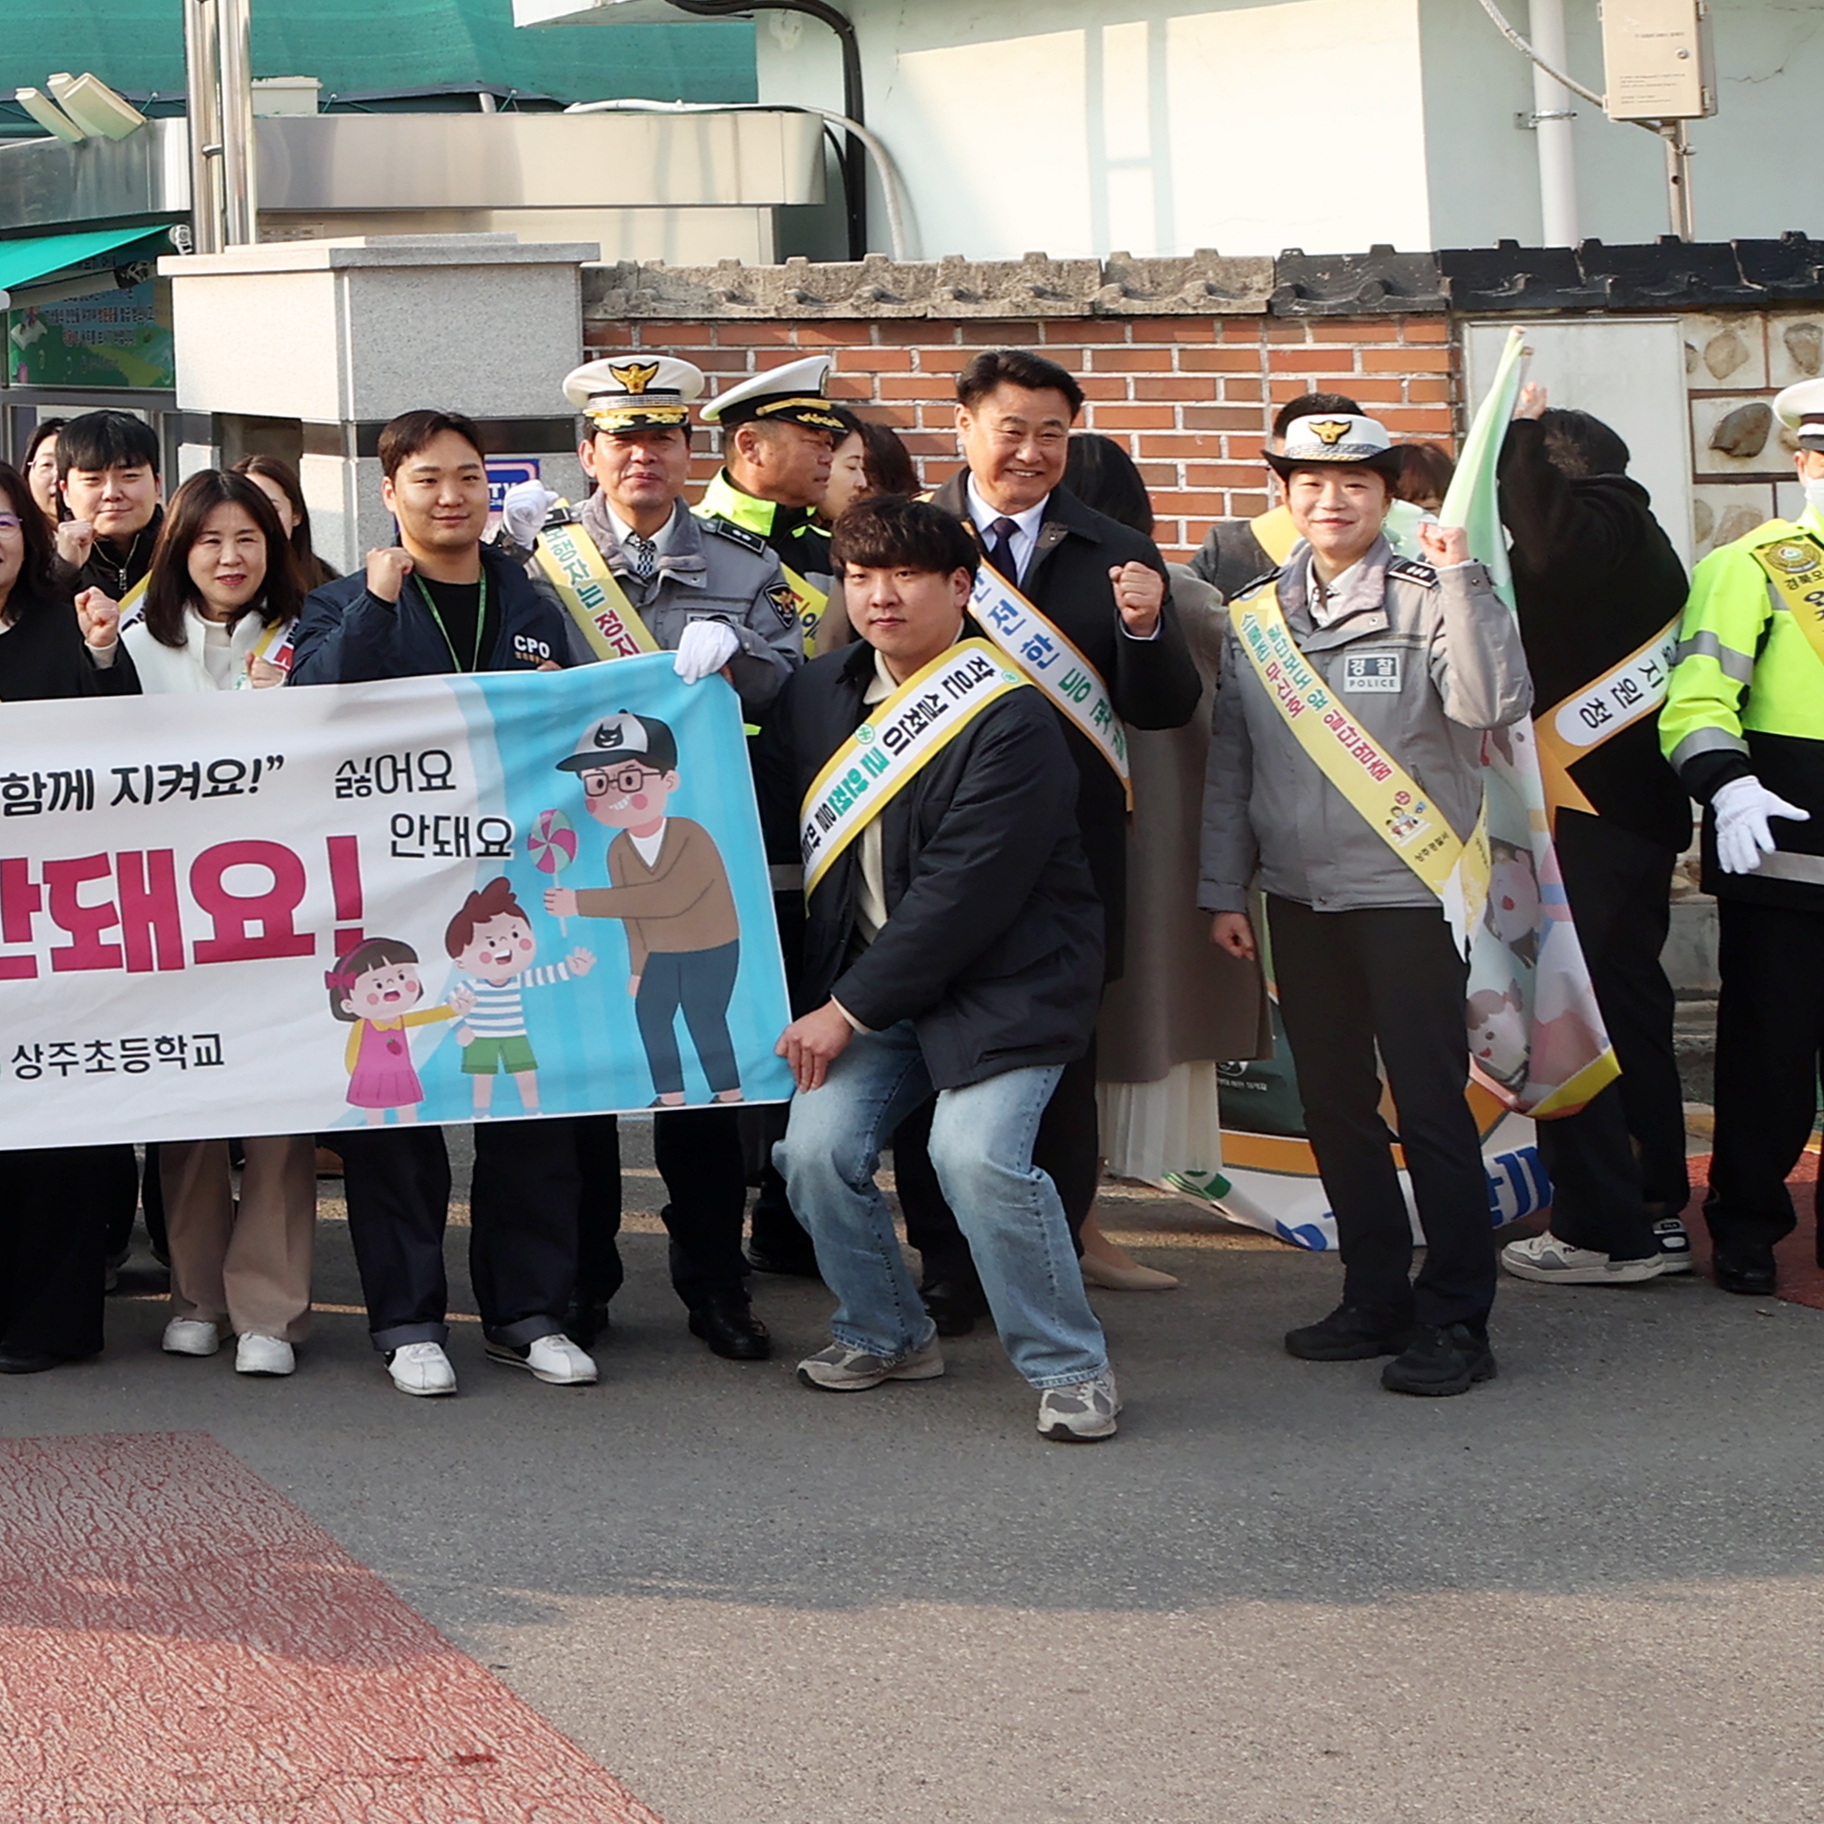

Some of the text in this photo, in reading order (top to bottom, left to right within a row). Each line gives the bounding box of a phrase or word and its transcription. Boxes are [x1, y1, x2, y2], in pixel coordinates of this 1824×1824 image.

[514, 634, 550, 659] CPO
[594, 608, 642, 658] 정지
[1240, 610, 1306, 719] 스쿨존 무신호
[1349, 678, 1396, 688] POLICE
[1266, 624, 1394, 784] 횡단보도 앞 일단멈춤
[815, 655, 996, 834] 작은 실천이 큰 안전을
[110, 755, 288, 810] 지켜요!”
[333, 747, 458, 803] 싫어요
[388, 809, 515, 862] 안돼요
[10, 1032, 226, 1081] 상주초등학교
